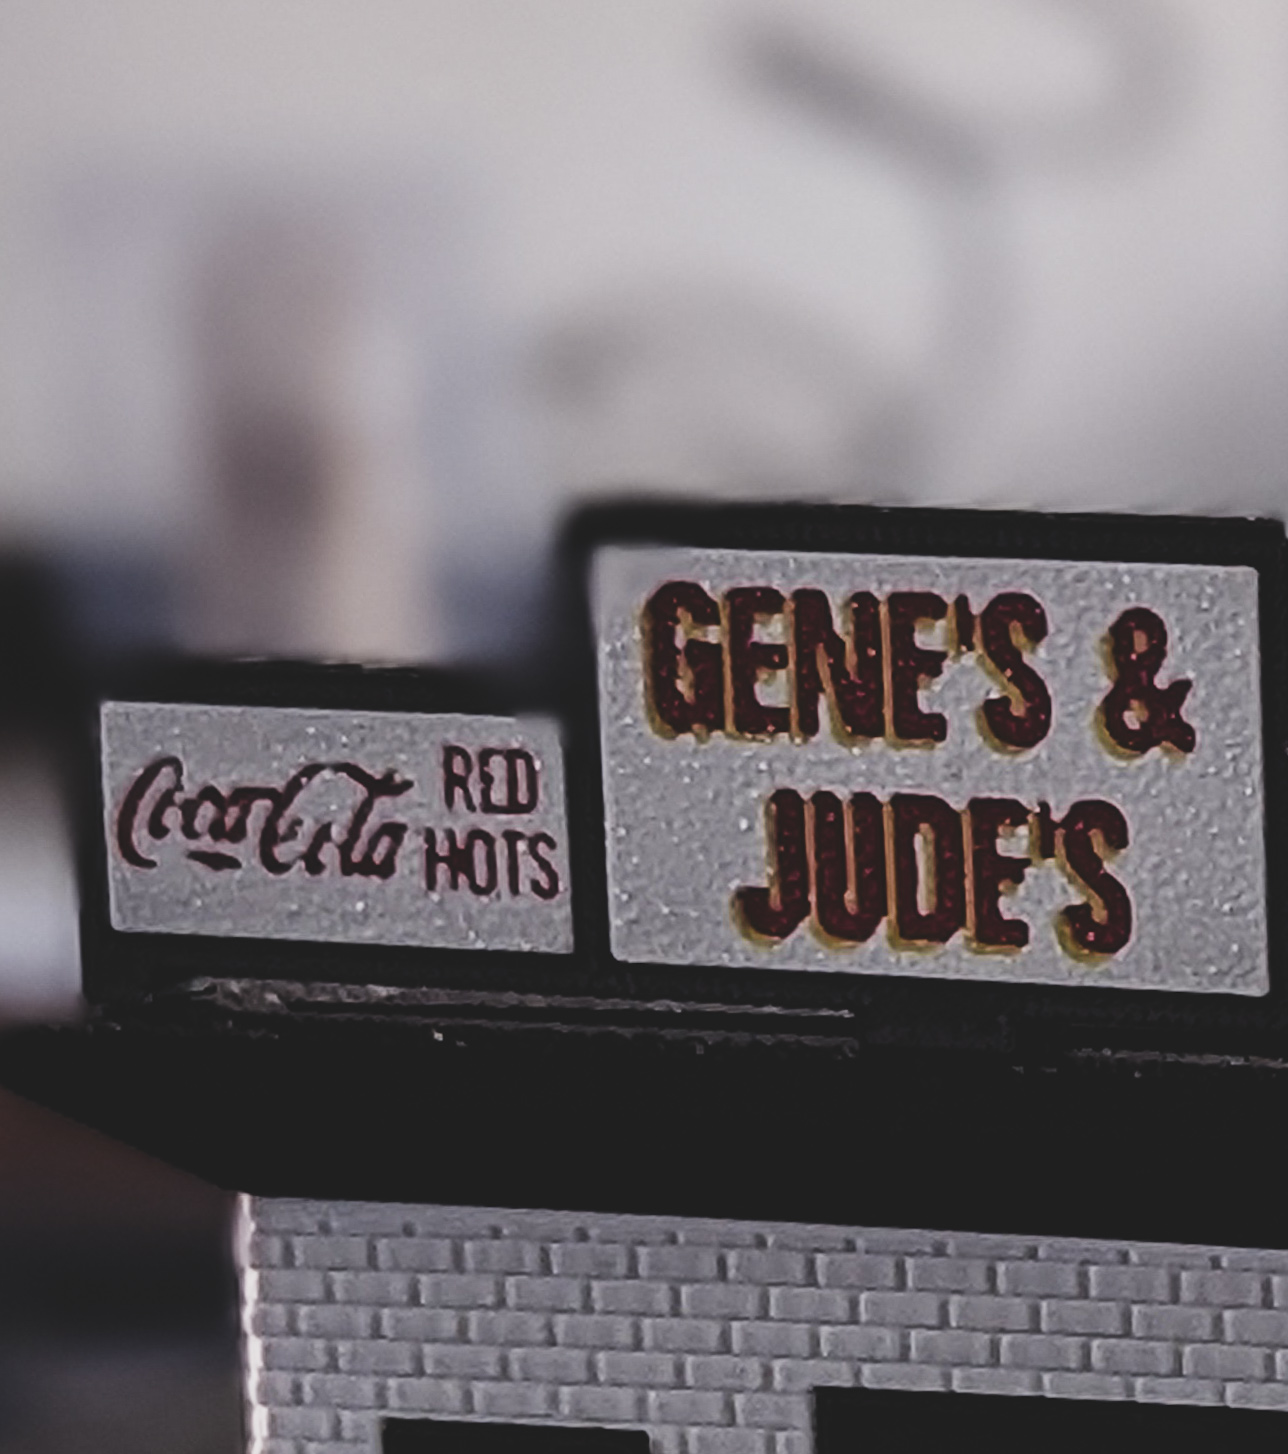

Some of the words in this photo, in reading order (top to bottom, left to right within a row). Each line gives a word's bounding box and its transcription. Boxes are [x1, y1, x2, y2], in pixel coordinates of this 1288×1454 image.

[641, 579, 1052, 754] GENE'S
[1096, 607, 1196, 762] &
[443, 745, 540, 815] RED
[424, 828, 559, 900] HOTS
[729, 788, 1134, 966] JUDE'S
